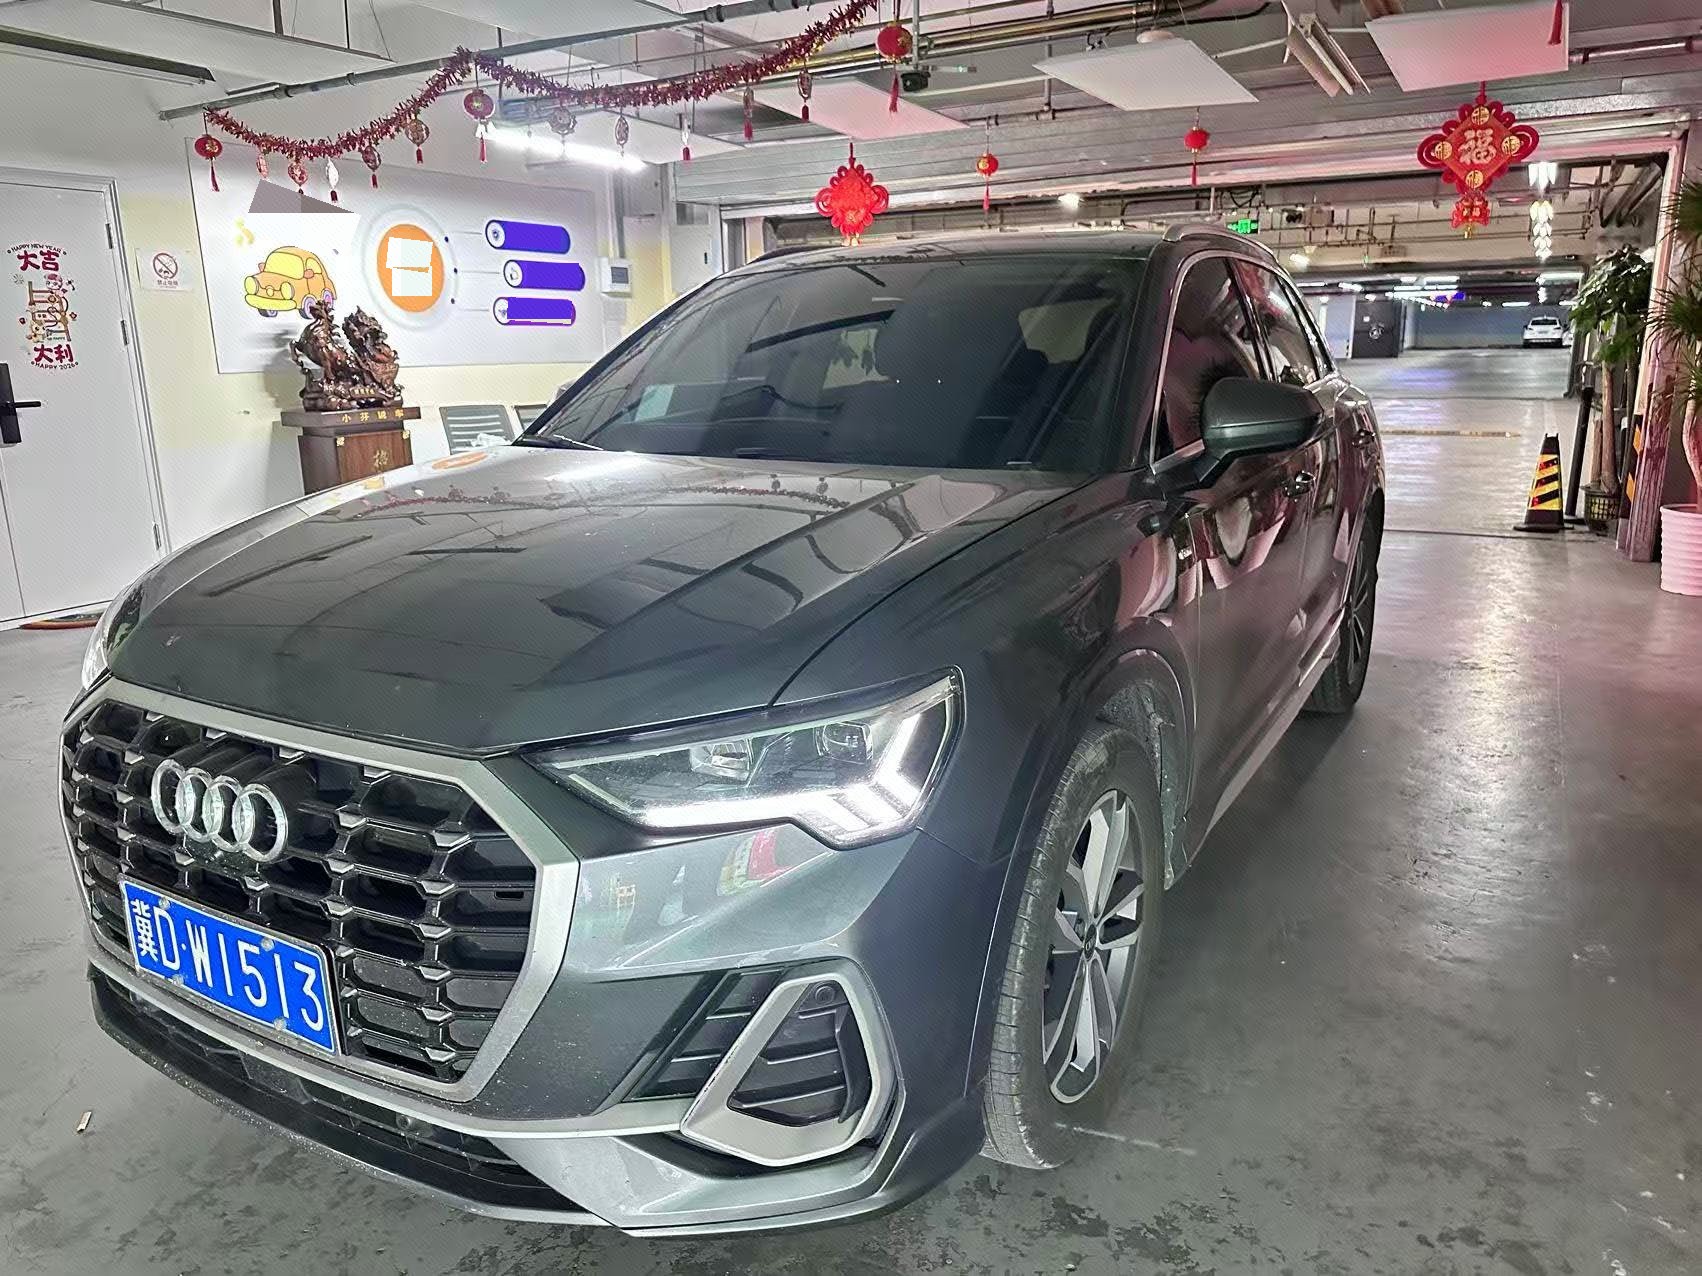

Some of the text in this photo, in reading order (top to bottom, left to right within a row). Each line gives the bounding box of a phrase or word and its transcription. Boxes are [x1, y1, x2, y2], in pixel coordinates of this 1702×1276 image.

[1458, 128, 1497, 164] 福
[11, 244, 29, 252] HAPPY
[45, 244, 62, 253] YEAR
[17, 250, 60, 271] 大吉
[33, 343, 74, 363] 大利
[35, 362, 57, 370] HAPPY
